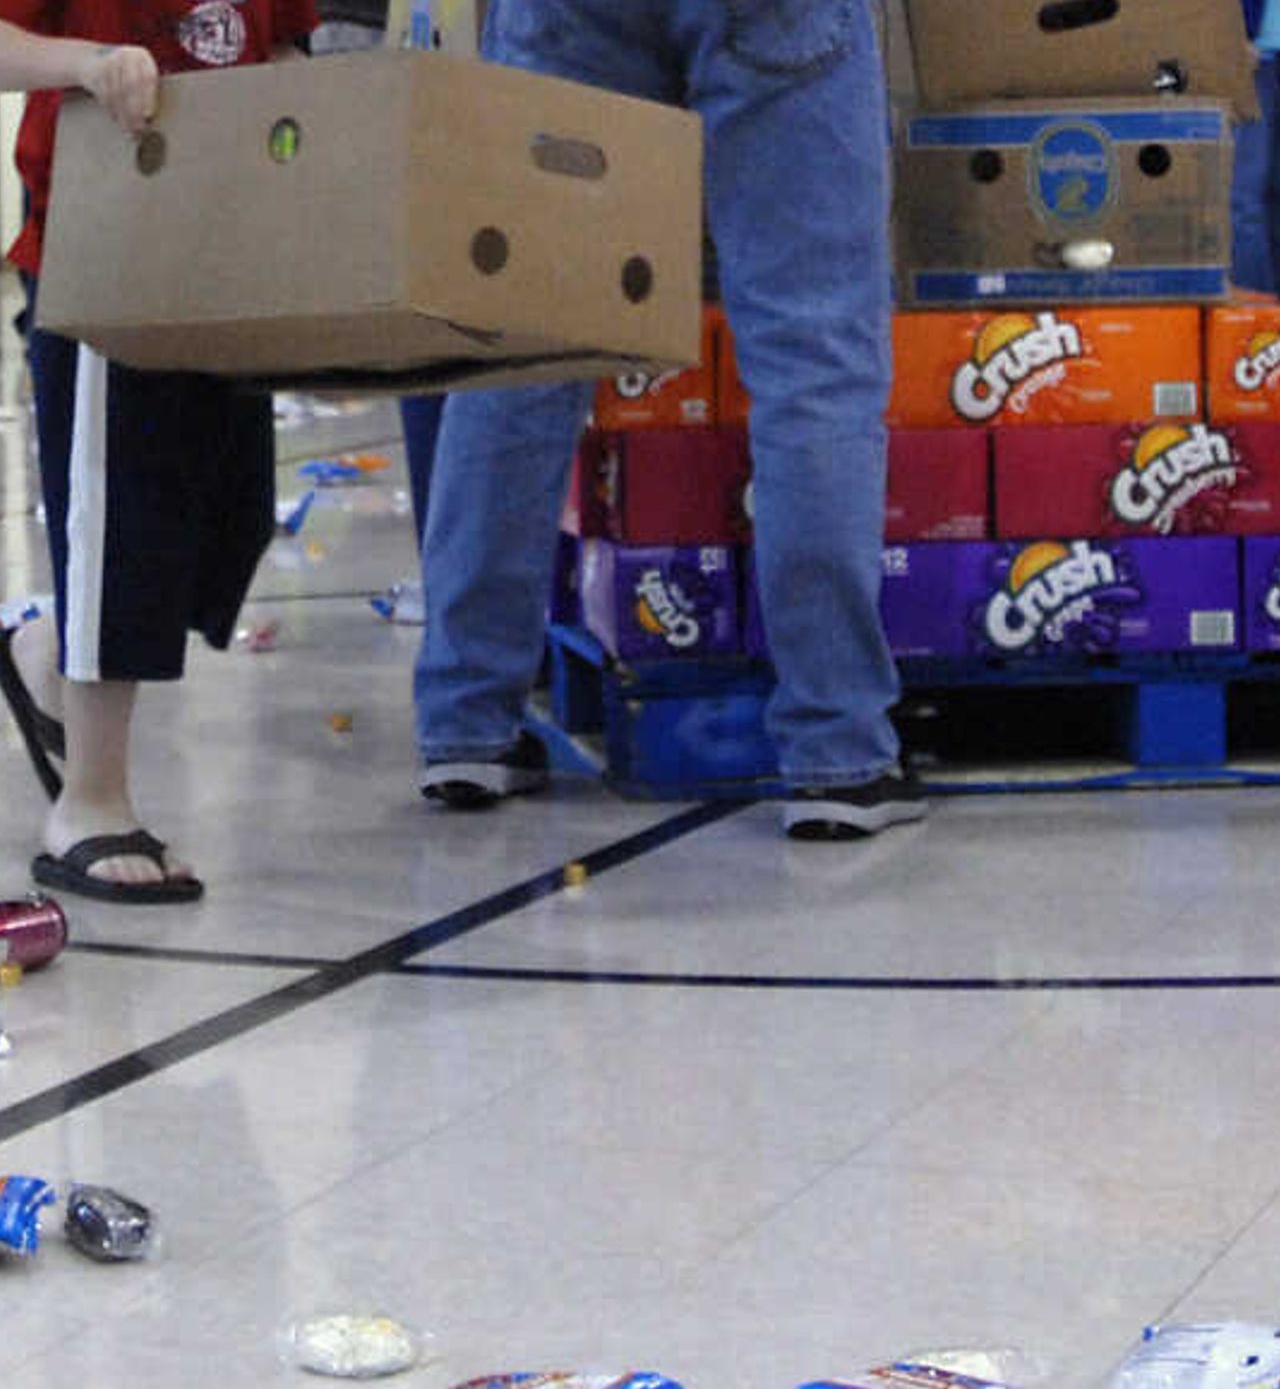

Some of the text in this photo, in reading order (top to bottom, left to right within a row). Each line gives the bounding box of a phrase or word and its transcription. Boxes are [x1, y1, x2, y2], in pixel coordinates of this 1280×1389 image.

[951, 310, 1083, 422] Crush
[1111, 423, 1233, 523] Crush
[636, 570, 700, 648] Crush
[880, 547, 910, 571] 12
[984, 539, 1117, 651] Crush
